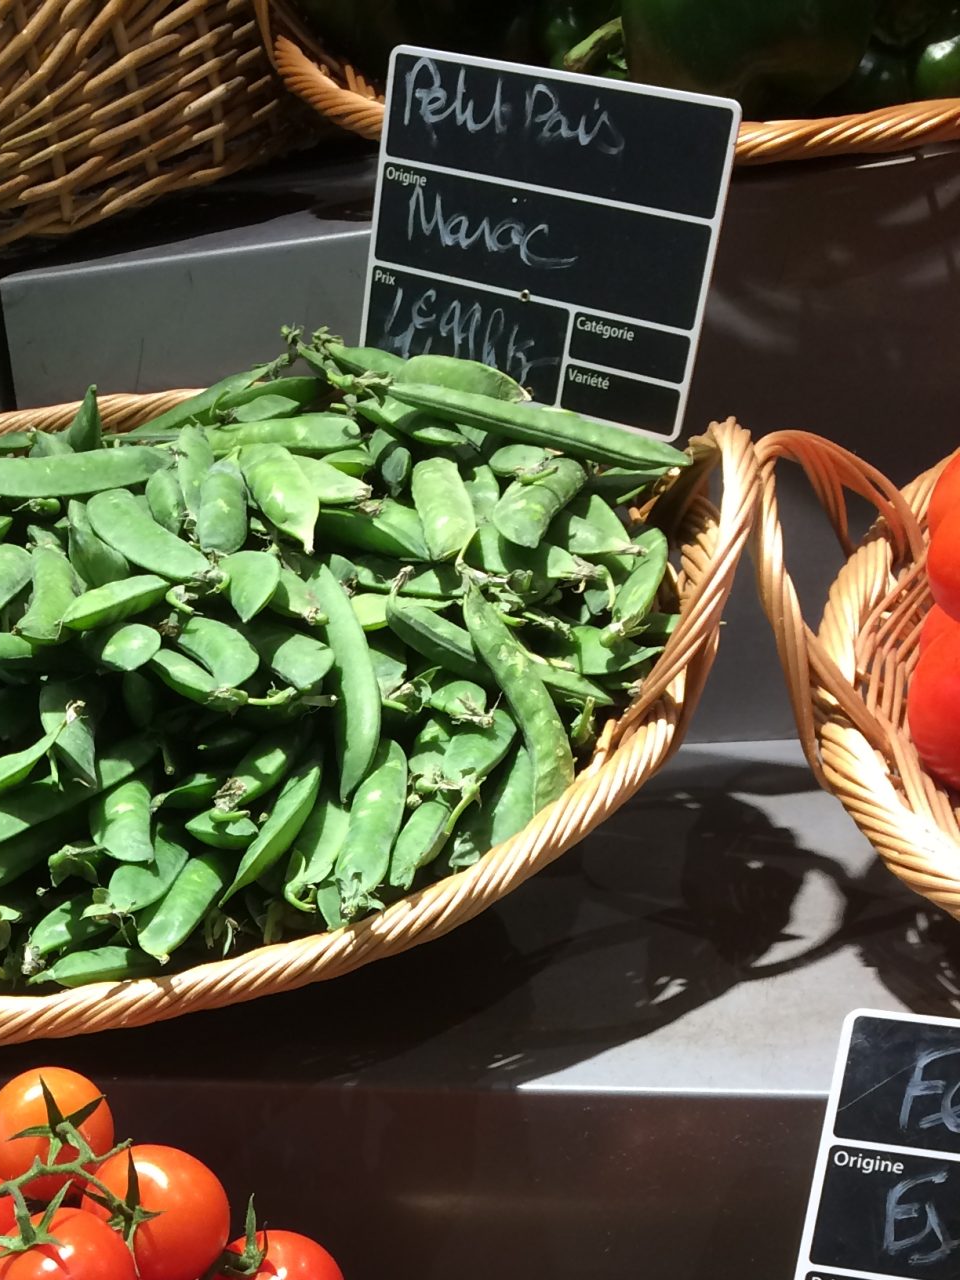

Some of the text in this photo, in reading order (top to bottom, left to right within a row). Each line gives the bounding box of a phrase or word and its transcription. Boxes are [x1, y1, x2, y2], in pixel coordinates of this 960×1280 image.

[386, 166, 428, 188] Origine
[374, 269, 396, 286] Prix
[576, 316, 635, 342] Catégorie
[568, 369, 610, 391] Variété
[833, 1150, 905, 1175] Origine
